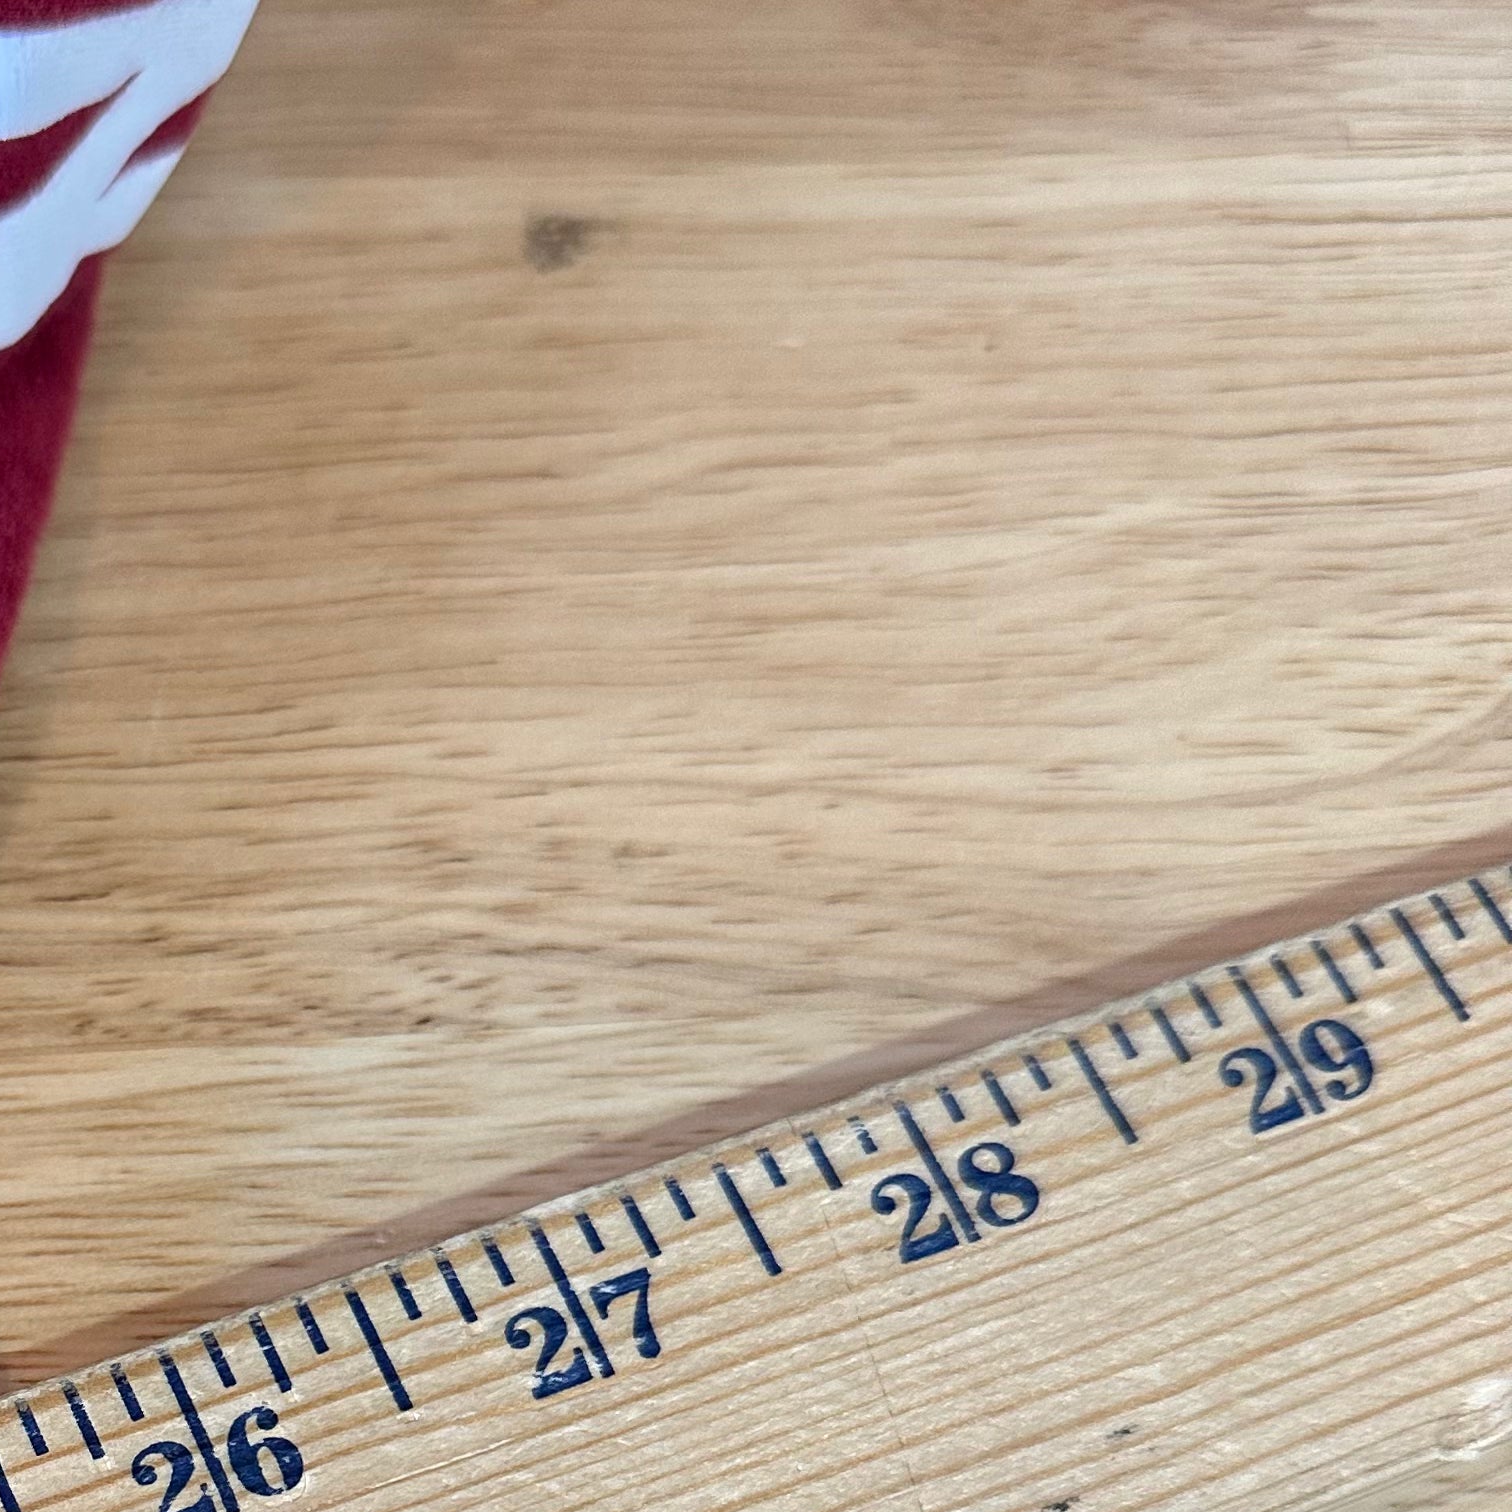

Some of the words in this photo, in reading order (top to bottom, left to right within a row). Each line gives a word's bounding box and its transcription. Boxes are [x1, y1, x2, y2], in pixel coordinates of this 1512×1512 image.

[505, 1267, 662, 1399] 27
[871, 1142, 1040, 1263] 28
[1219, 1019, 1374, 1134] 29
